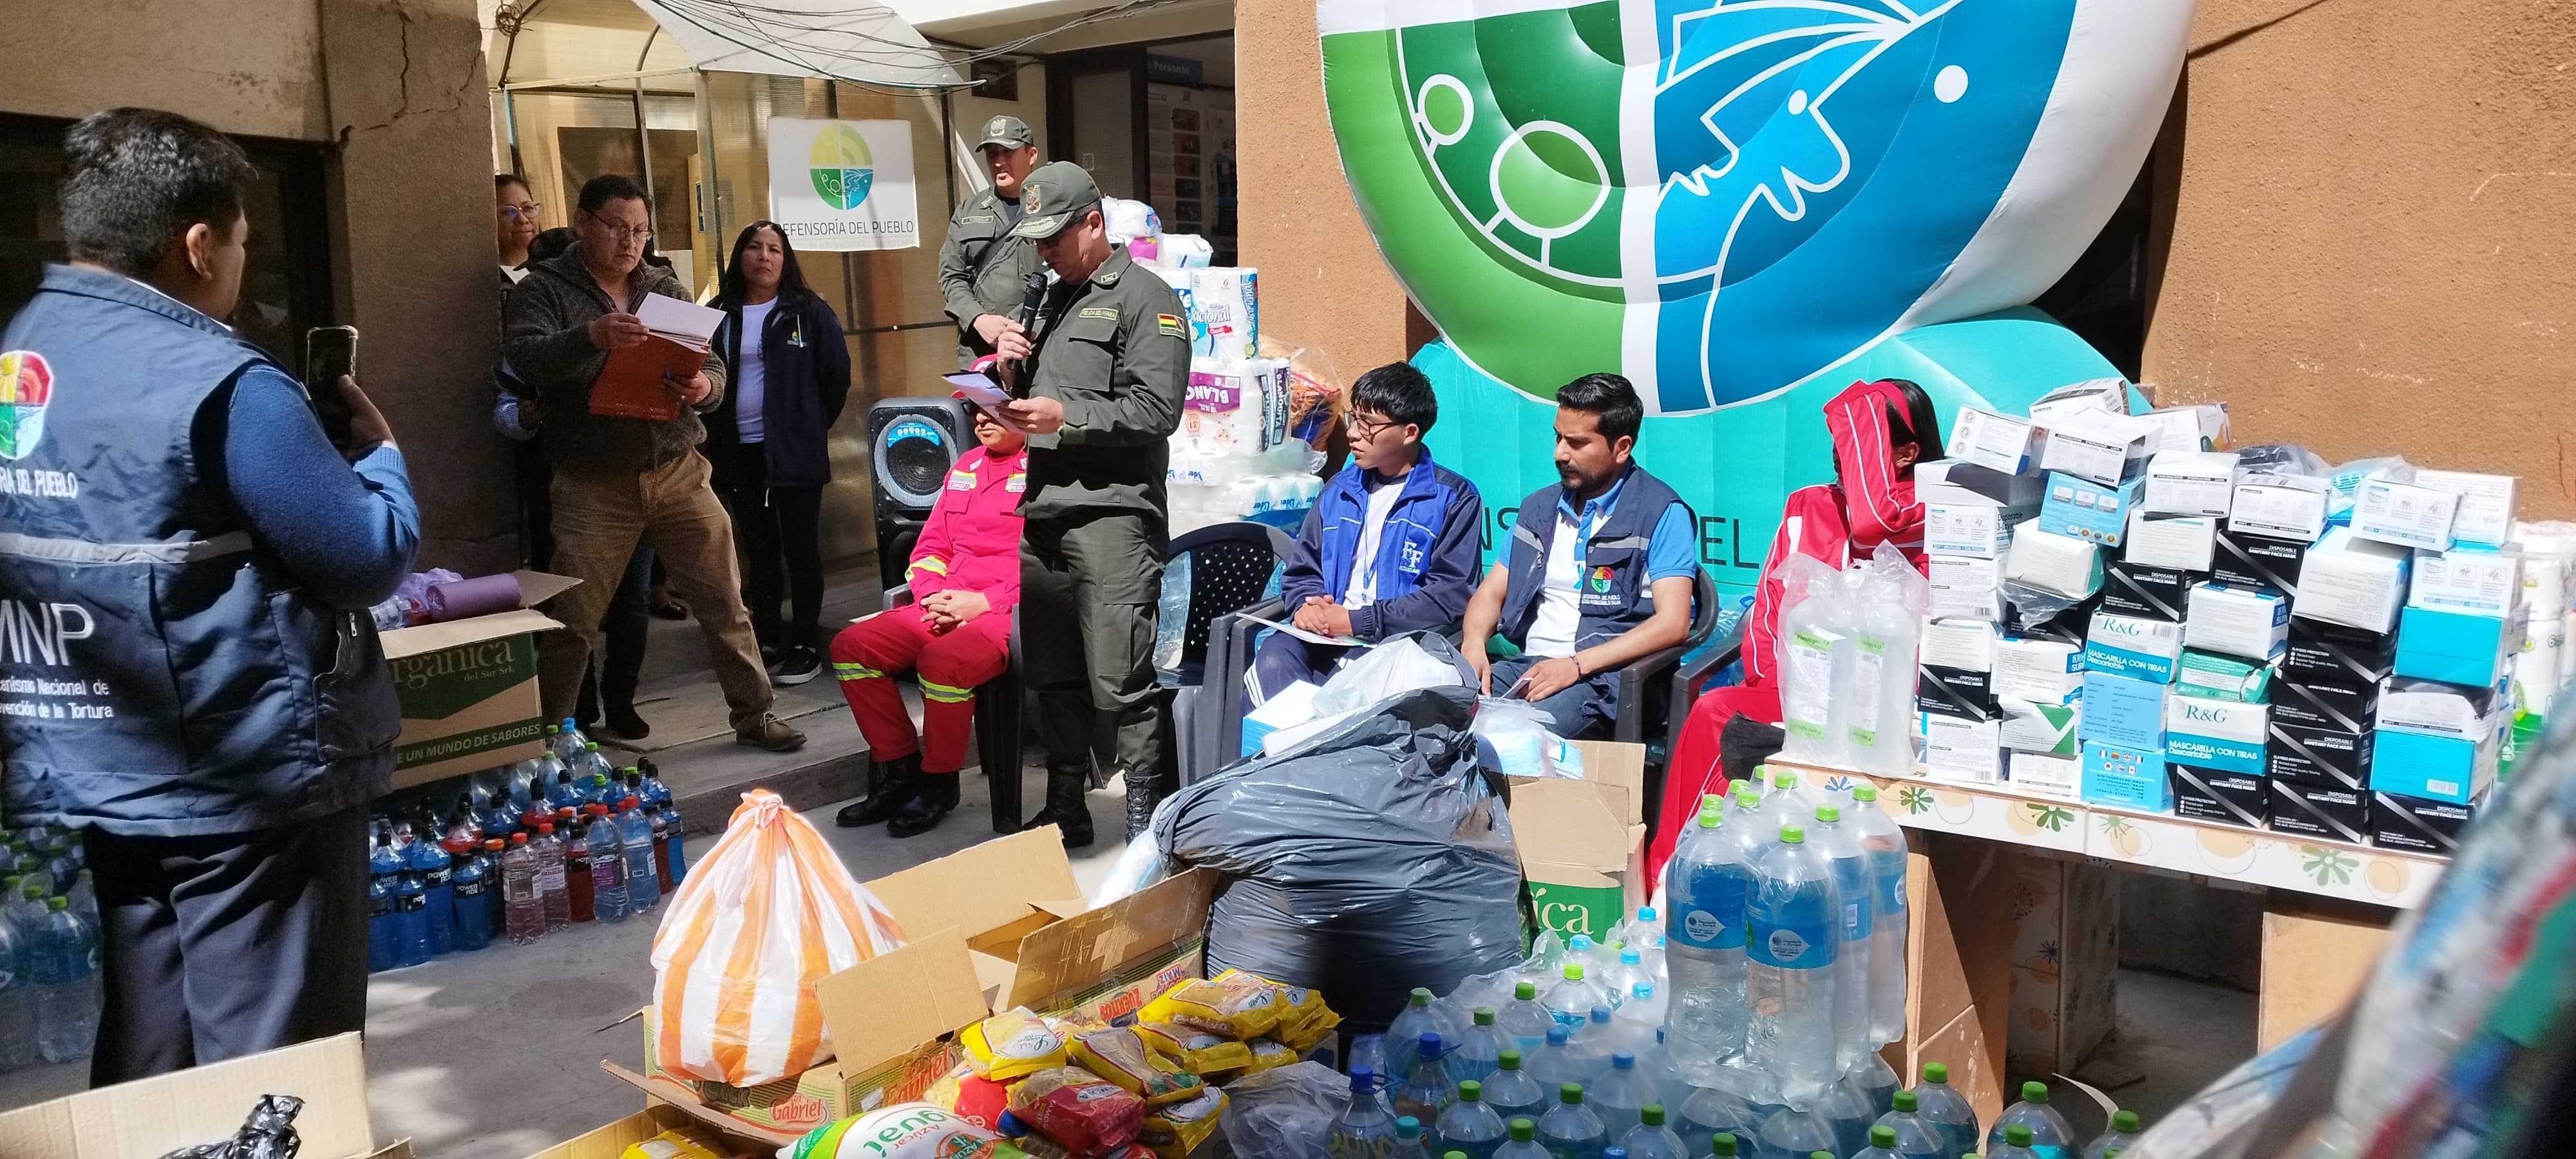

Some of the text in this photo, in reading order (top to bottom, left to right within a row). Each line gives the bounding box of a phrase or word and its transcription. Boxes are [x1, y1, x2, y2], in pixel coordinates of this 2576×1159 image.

[849, 221, 869, 235] DEL
[872, 220, 914, 234] PUEBLO
[34, 469, 79, 499] PUEBLO
[2269, 545, 2297, 554] DISPOSABLE
[2102, 616, 2143, 637] R&G
[2087, 648, 2168, 674] MASCARILLA CON TIRAS
[2087, 655, 2125, 671] Descartable
[464, 672, 479, 682] del
[480, 668, 497, 679] Sur
[36, 677, 87, 696] Nacional
[93, 679, 109, 696] de
[38, 701, 50, 719] de
[53, 702, 64, 719] la
[68, 702, 114, 719] Tortura
[2185, 704, 2228, 723] R&G
[406, 748, 424, 763] UN
[426, 739, 472, 757] MUNDO
[473, 735, 490, 748] DE
[491, 723, 540, 744] SABORES
[2303, 740, 2327, 748] SANITARY
[2324, 736, 2354, 745] DISPOSABLE
[2168, 740, 2258, 760] MASCARILLA CON TIRAS
[2168, 747, 2213, 760] Descartable
[2228, 777, 2257, 786] DISPOSABLE
[2307, 794, 2331, 802] SANITARY
[2327, 791, 2357, 800] DISPOSABLE
[2414, 809, 2439, 817] SANITARY
[2436, 805, 2468, 814] DISPOSABLE
[456, 883, 478, 892] POWER
[772, 1098, 822, 1122] Gabriel
[893, 1123, 943, 1149] Azúcar
